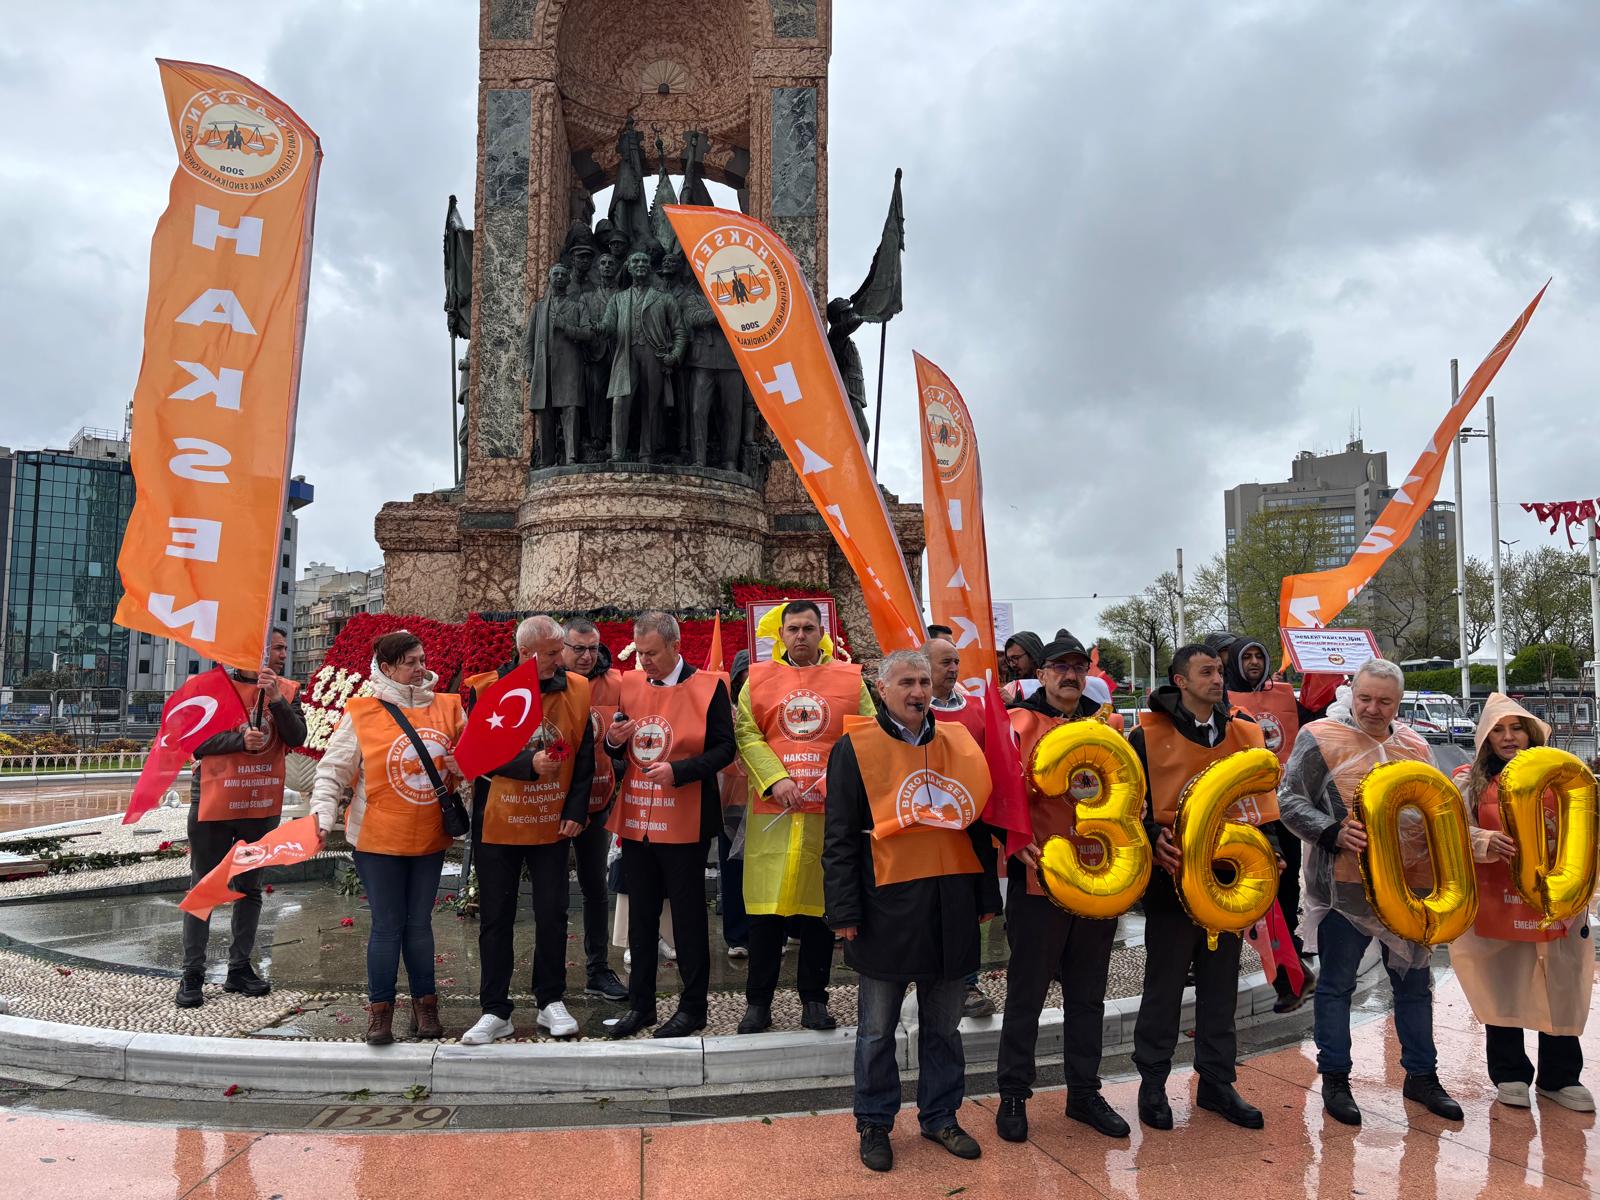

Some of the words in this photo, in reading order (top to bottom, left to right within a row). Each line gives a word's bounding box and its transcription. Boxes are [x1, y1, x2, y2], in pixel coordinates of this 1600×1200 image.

[783, 752, 821, 763] HAKSEN
[237, 763, 273, 774] HAKSEN
[523, 781, 560, 793] HAKSEN
[500, 792, 521, 805] KAMU
[538, 804, 549, 814] VE
[507, 814, 538, 824] EMEĞİN
[317, 1105, 452, 1129] 1339
